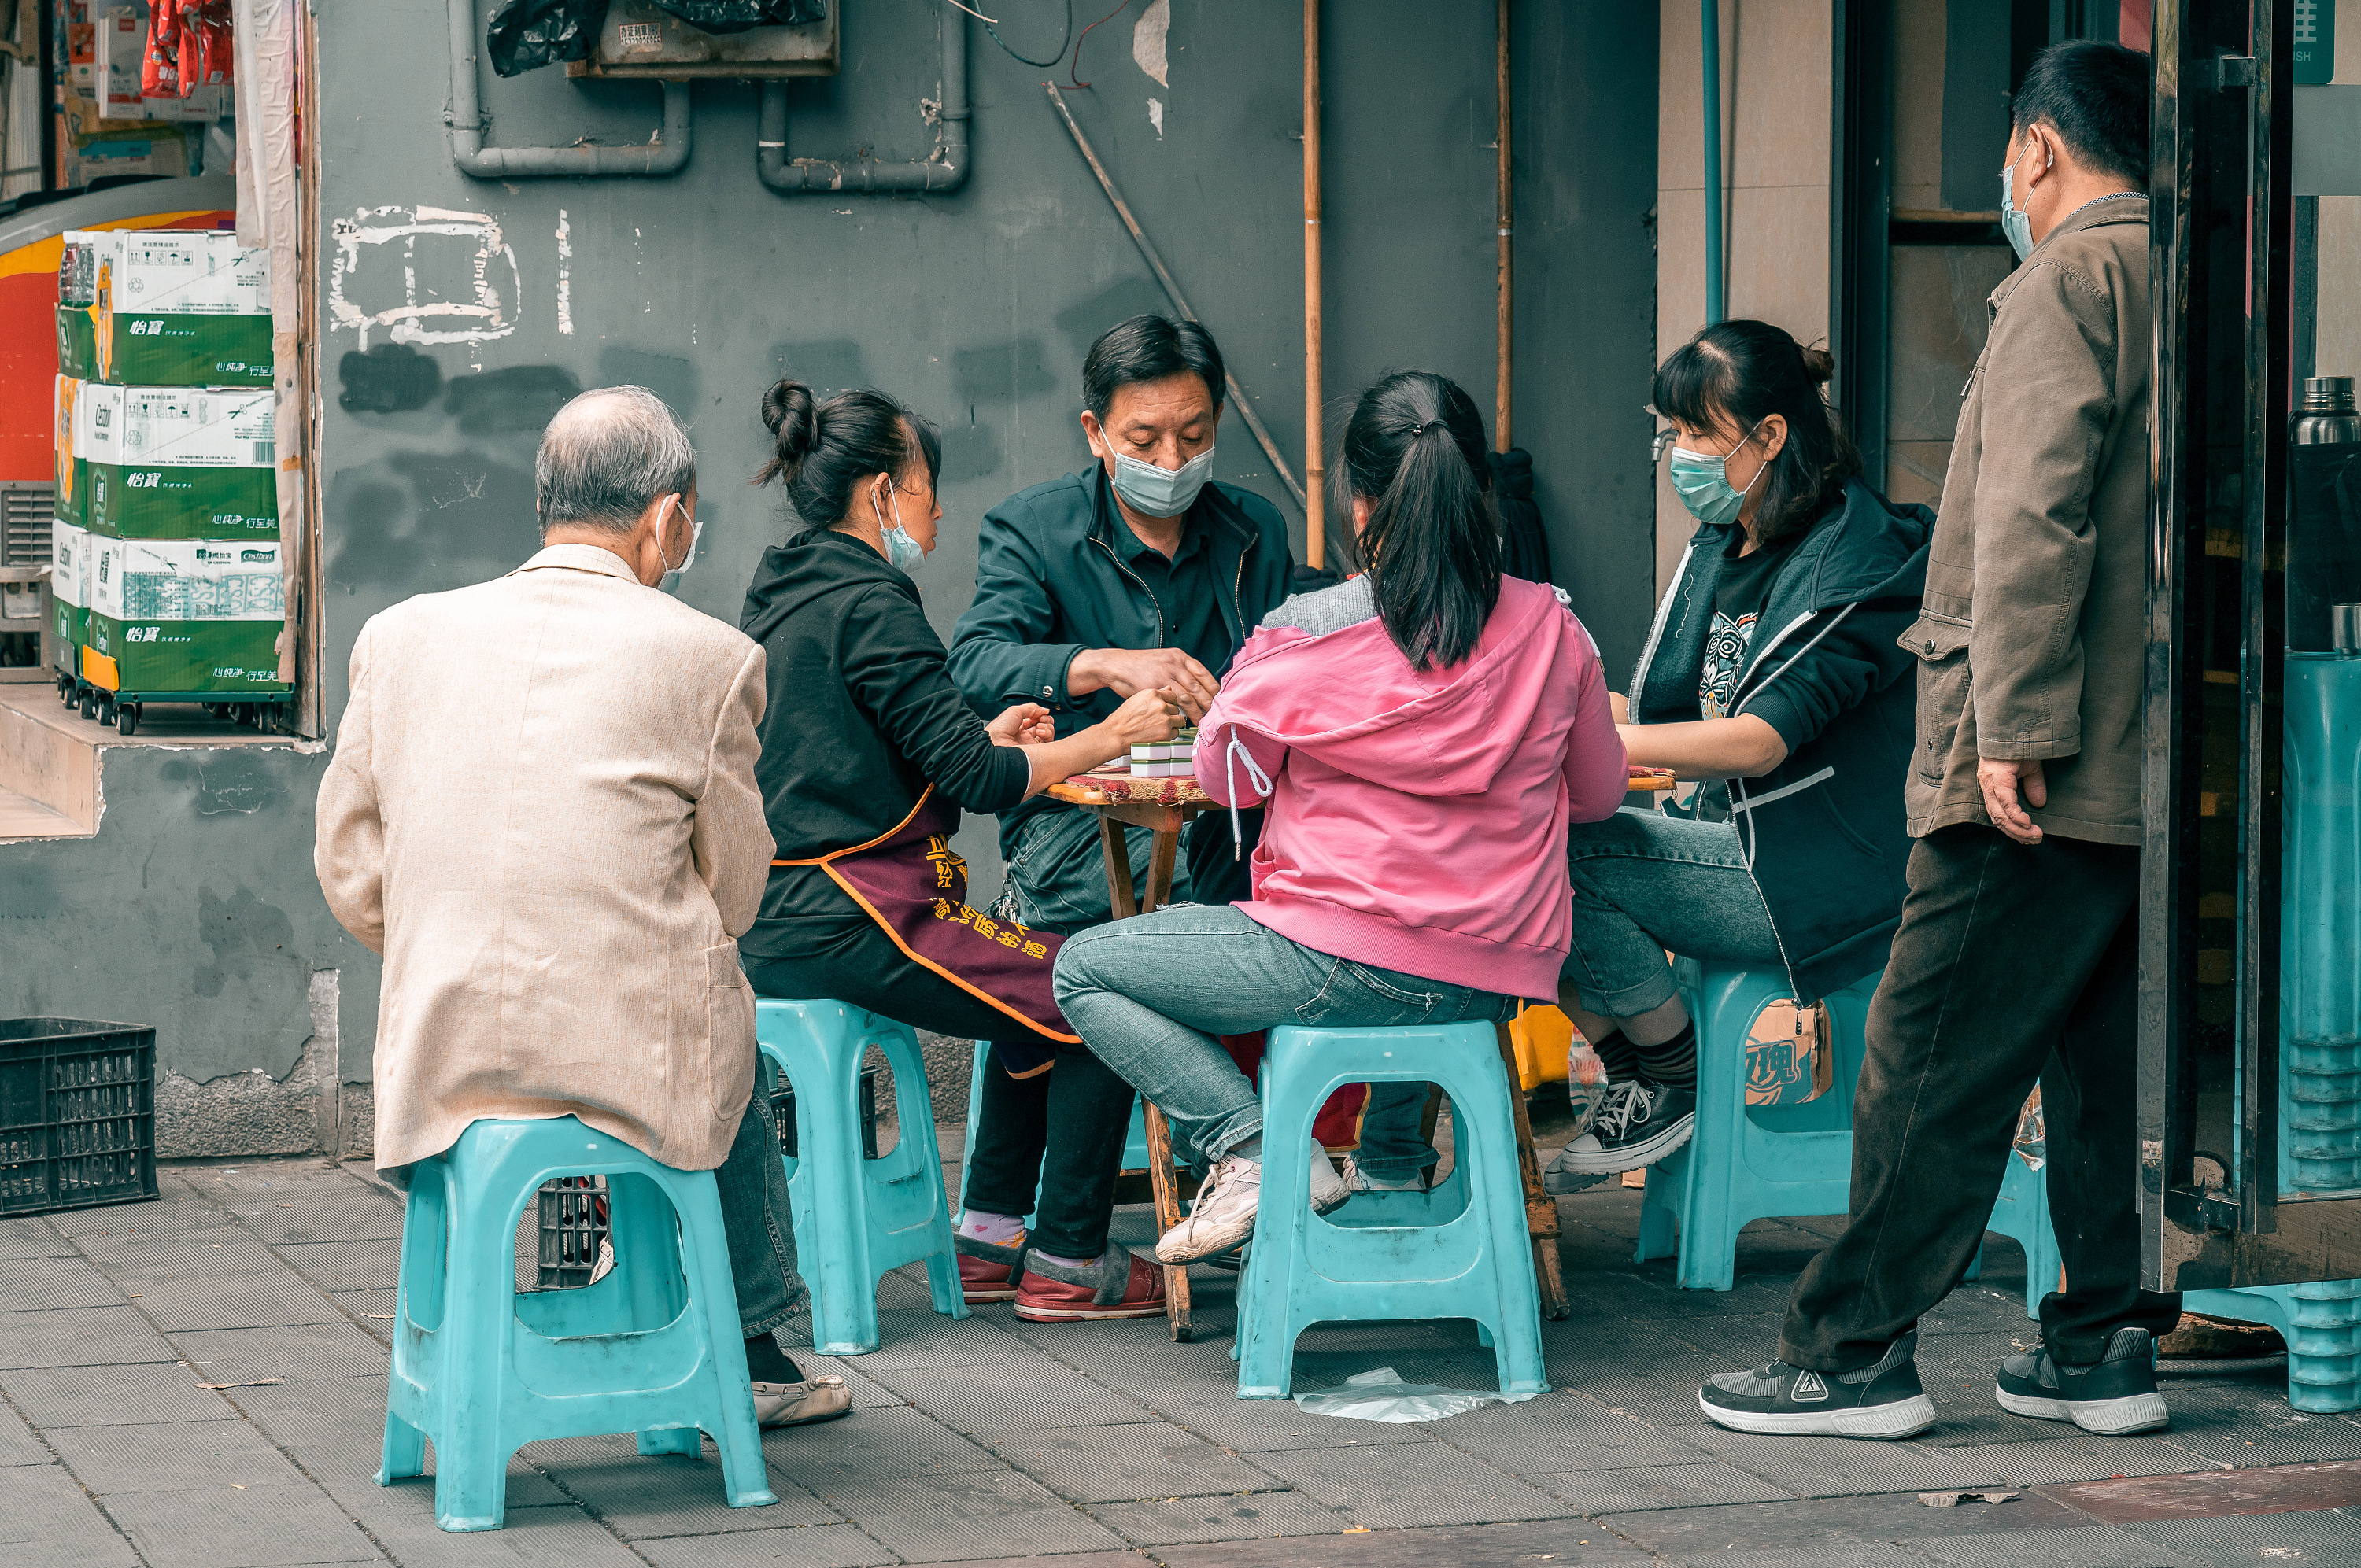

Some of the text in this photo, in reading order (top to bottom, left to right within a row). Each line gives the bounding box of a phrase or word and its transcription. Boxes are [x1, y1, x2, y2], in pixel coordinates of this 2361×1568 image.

[2293, 51, 2311, 61] SH
[129, 320, 164, 335] 怡寶
[127, 472, 161, 487] 怡寶
[125, 626, 161, 642] 怡寶
